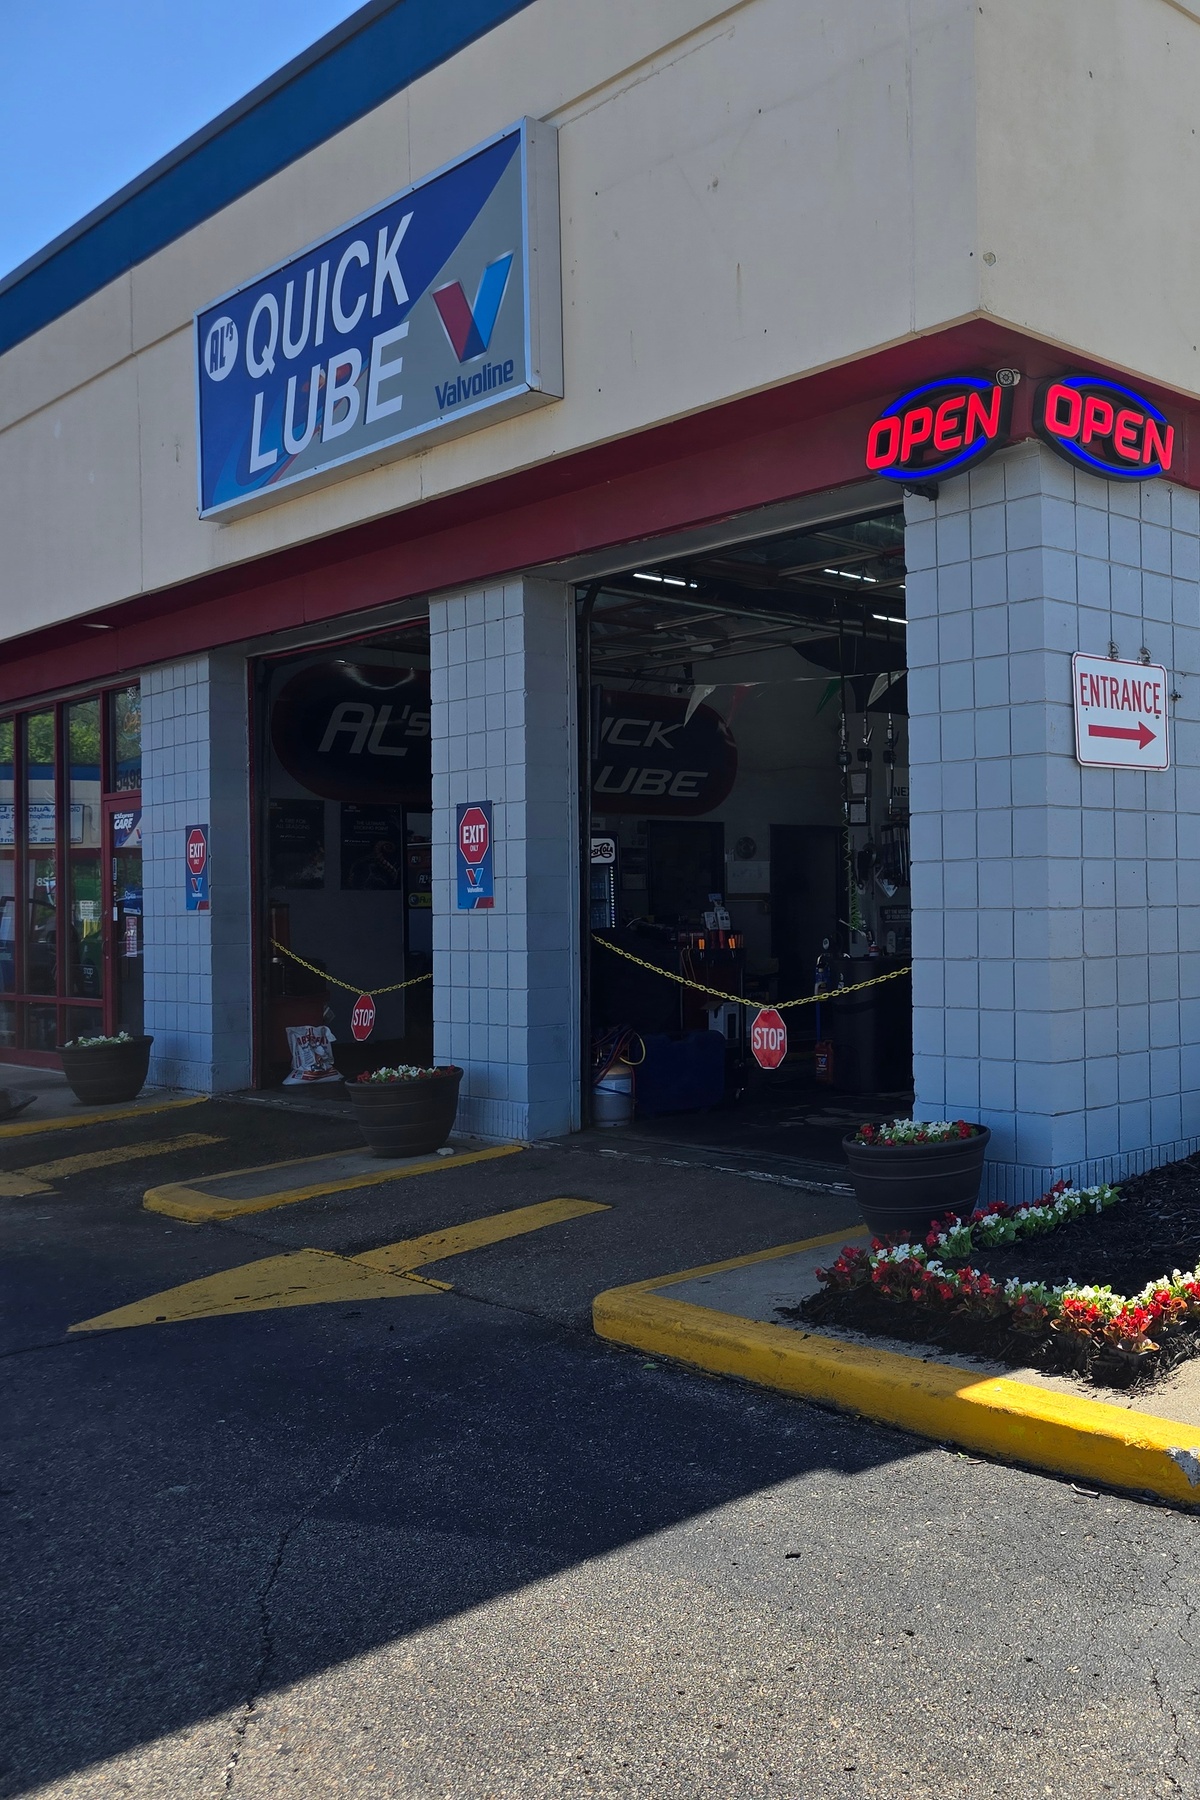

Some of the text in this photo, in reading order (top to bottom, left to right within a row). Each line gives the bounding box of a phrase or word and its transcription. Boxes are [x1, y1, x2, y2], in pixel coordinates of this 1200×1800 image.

[245, 211, 415, 379] QUICK
[249, 321, 410, 474] LUBE
[434, 358, 514, 410] Valvoline
[865, 385, 1003, 470] OPEN
[1044, 383, 1175, 471] OPEN
[1079, 672, 1162, 715] ENTRANCE
[600, 716, 684, 750] ICK
[593, 765, 709, 798] UBE
[189, 842, 204, 859] EXIT
[462, 824, 486, 844] EXIT
[353, 1008, 374, 1027] STOP
[753, 1026, 786, 1051] STOP
